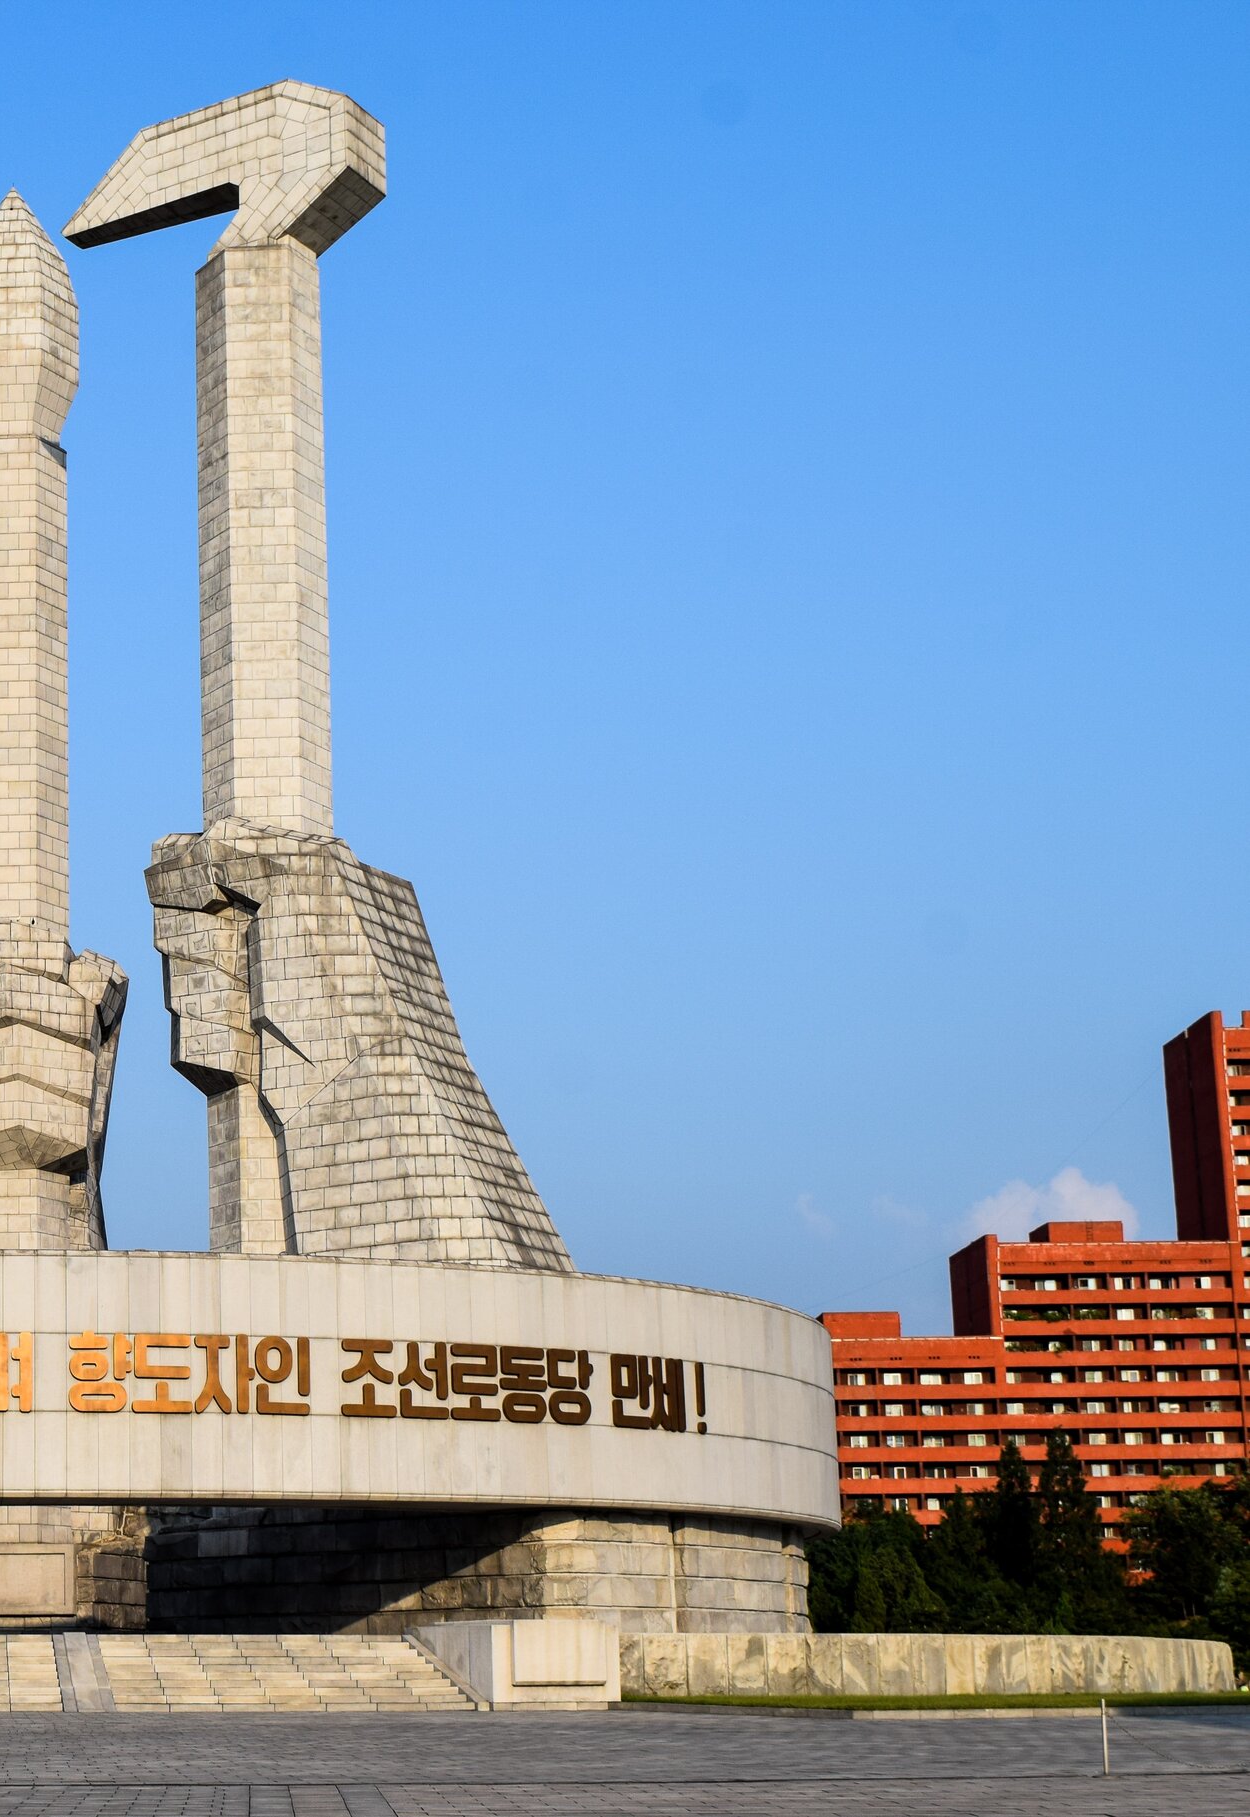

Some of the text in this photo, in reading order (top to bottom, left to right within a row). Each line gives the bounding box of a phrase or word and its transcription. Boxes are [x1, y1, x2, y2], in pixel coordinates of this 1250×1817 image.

[68, 1330, 311, 1416] 향도자인
[341, 1338, 594, 1426] 조선로동당
[610, 1352, 708, 1435] 만세!
